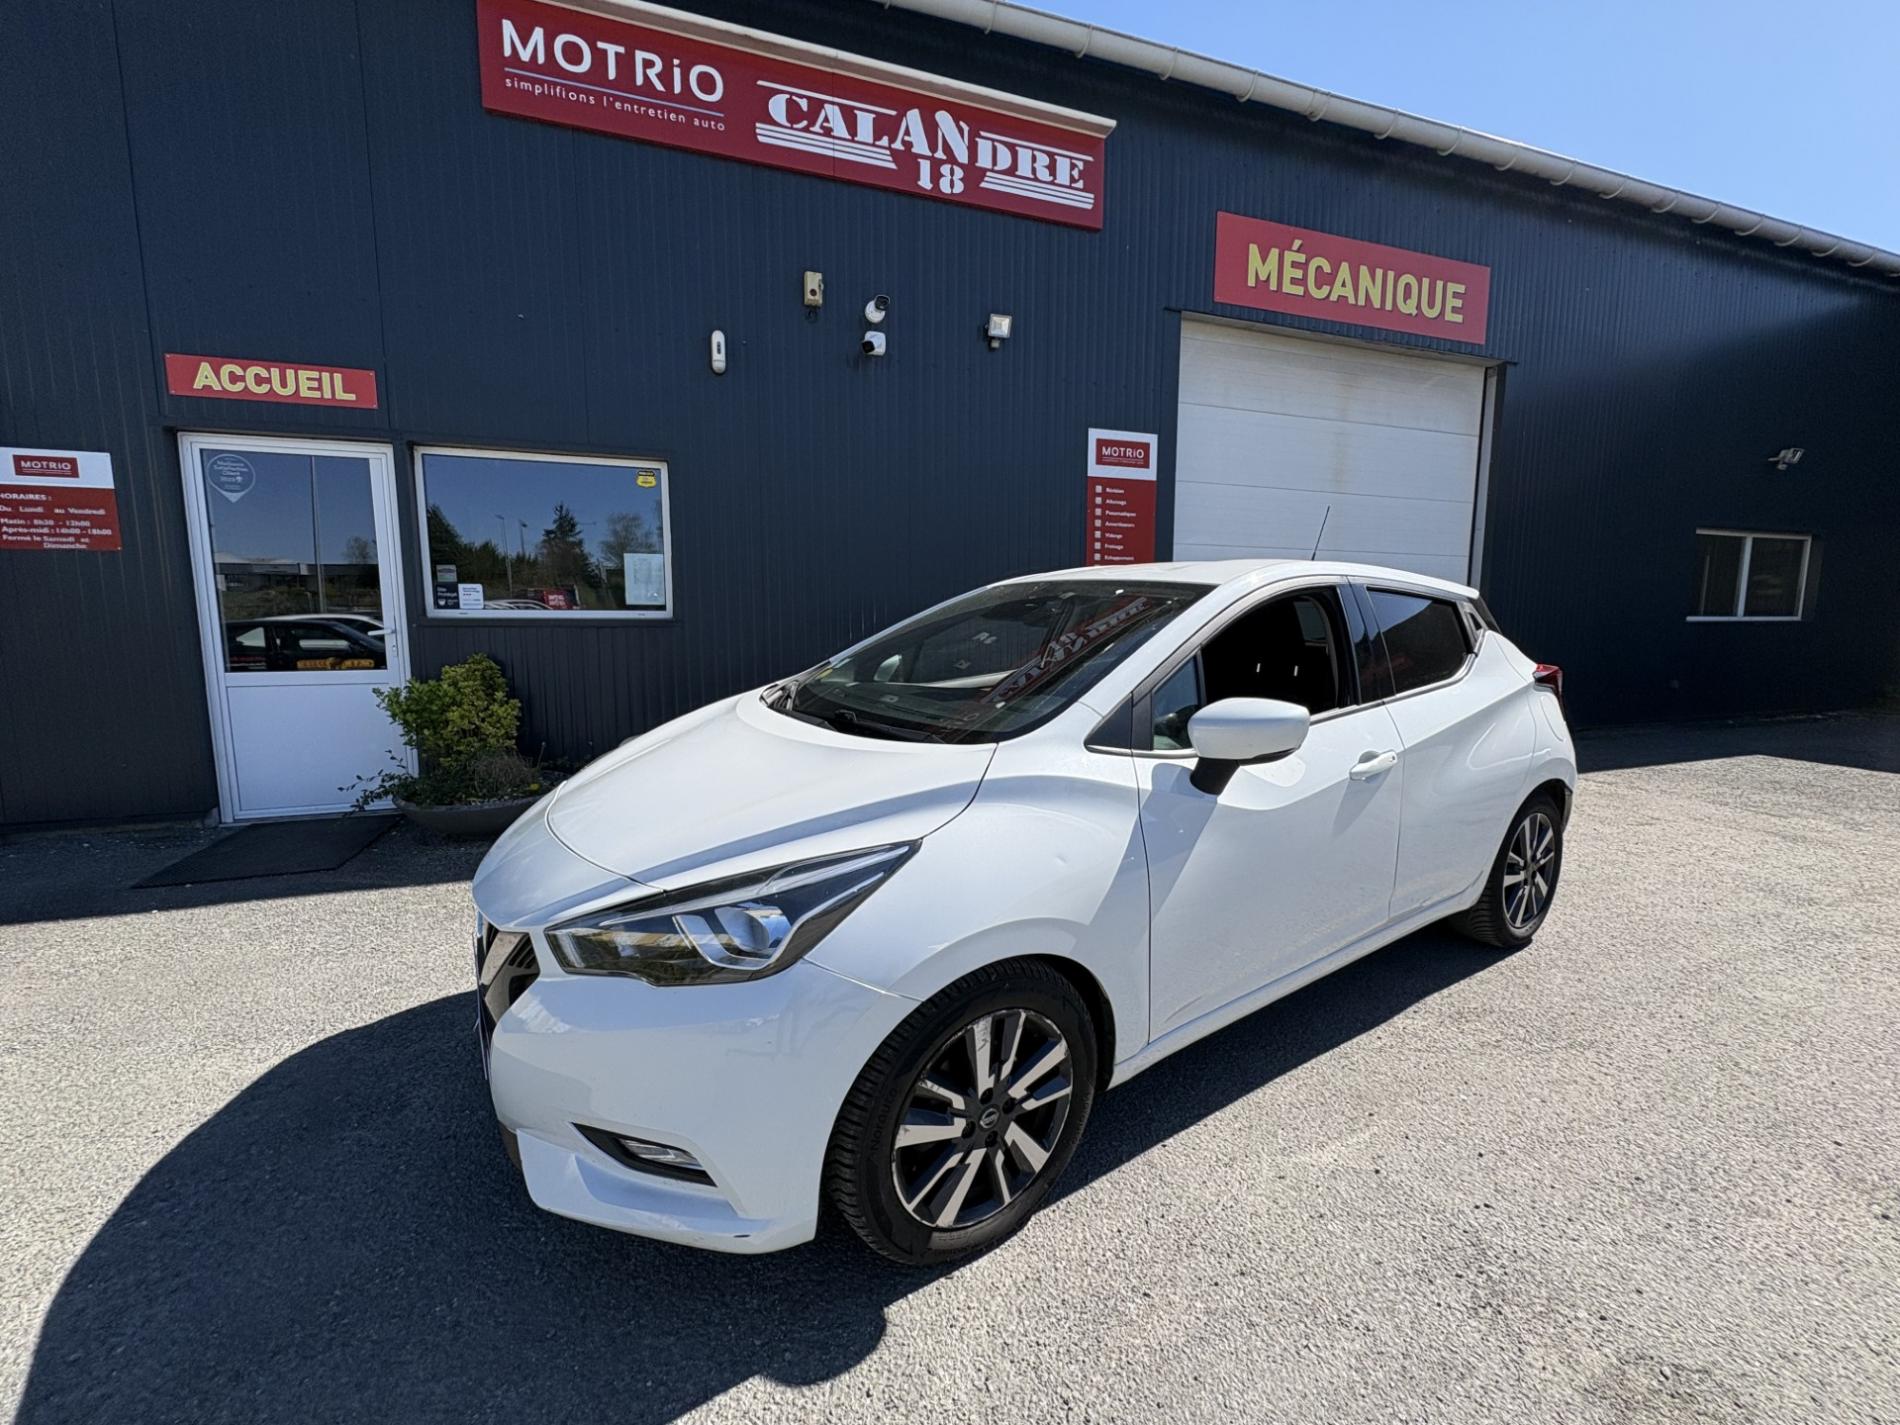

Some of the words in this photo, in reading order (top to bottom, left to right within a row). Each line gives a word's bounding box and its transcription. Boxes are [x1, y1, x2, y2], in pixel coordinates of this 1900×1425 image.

[505, 77, 596, 105] simplifions
[603, 96, 686, 124] l'entretien
[693, 117, 726, 131] auto
[768, 93, 1085, 189] CALANDRE
[917, 158, 965, 194] 18
[1247, 239, 1466, 323] MÉCANIQUE
[193, 361, 356, 401] ACCUEIL
